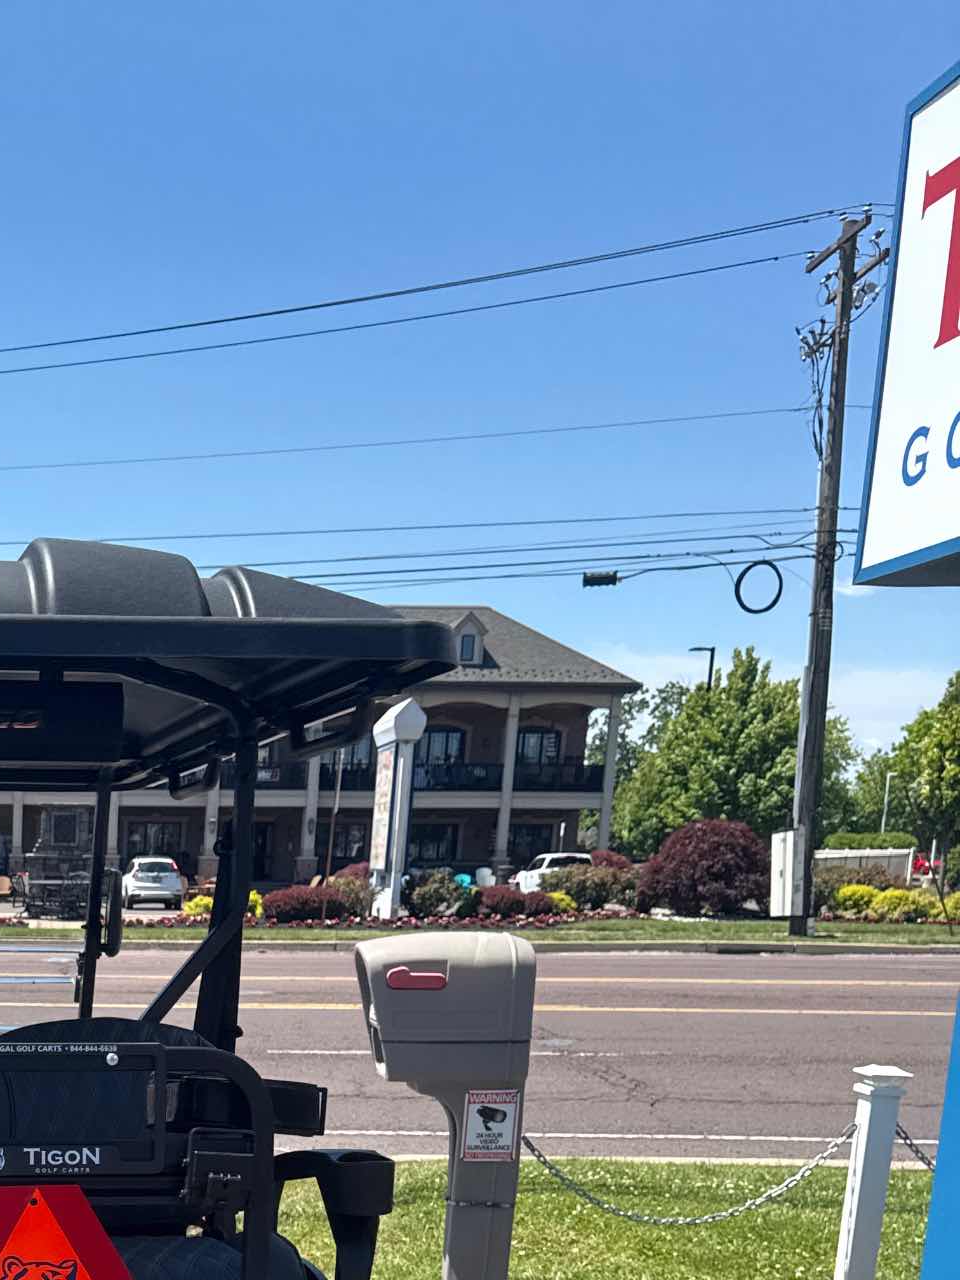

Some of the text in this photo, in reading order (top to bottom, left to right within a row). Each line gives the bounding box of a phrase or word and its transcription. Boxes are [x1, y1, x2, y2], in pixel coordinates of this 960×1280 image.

[16, 1045, 35, 1053] GOLF
[37, 1045, 62, 1053] CARTS
[470, 1094, 517, 1104] WARNING
[23, 1147, 100, 1166] TIGON
